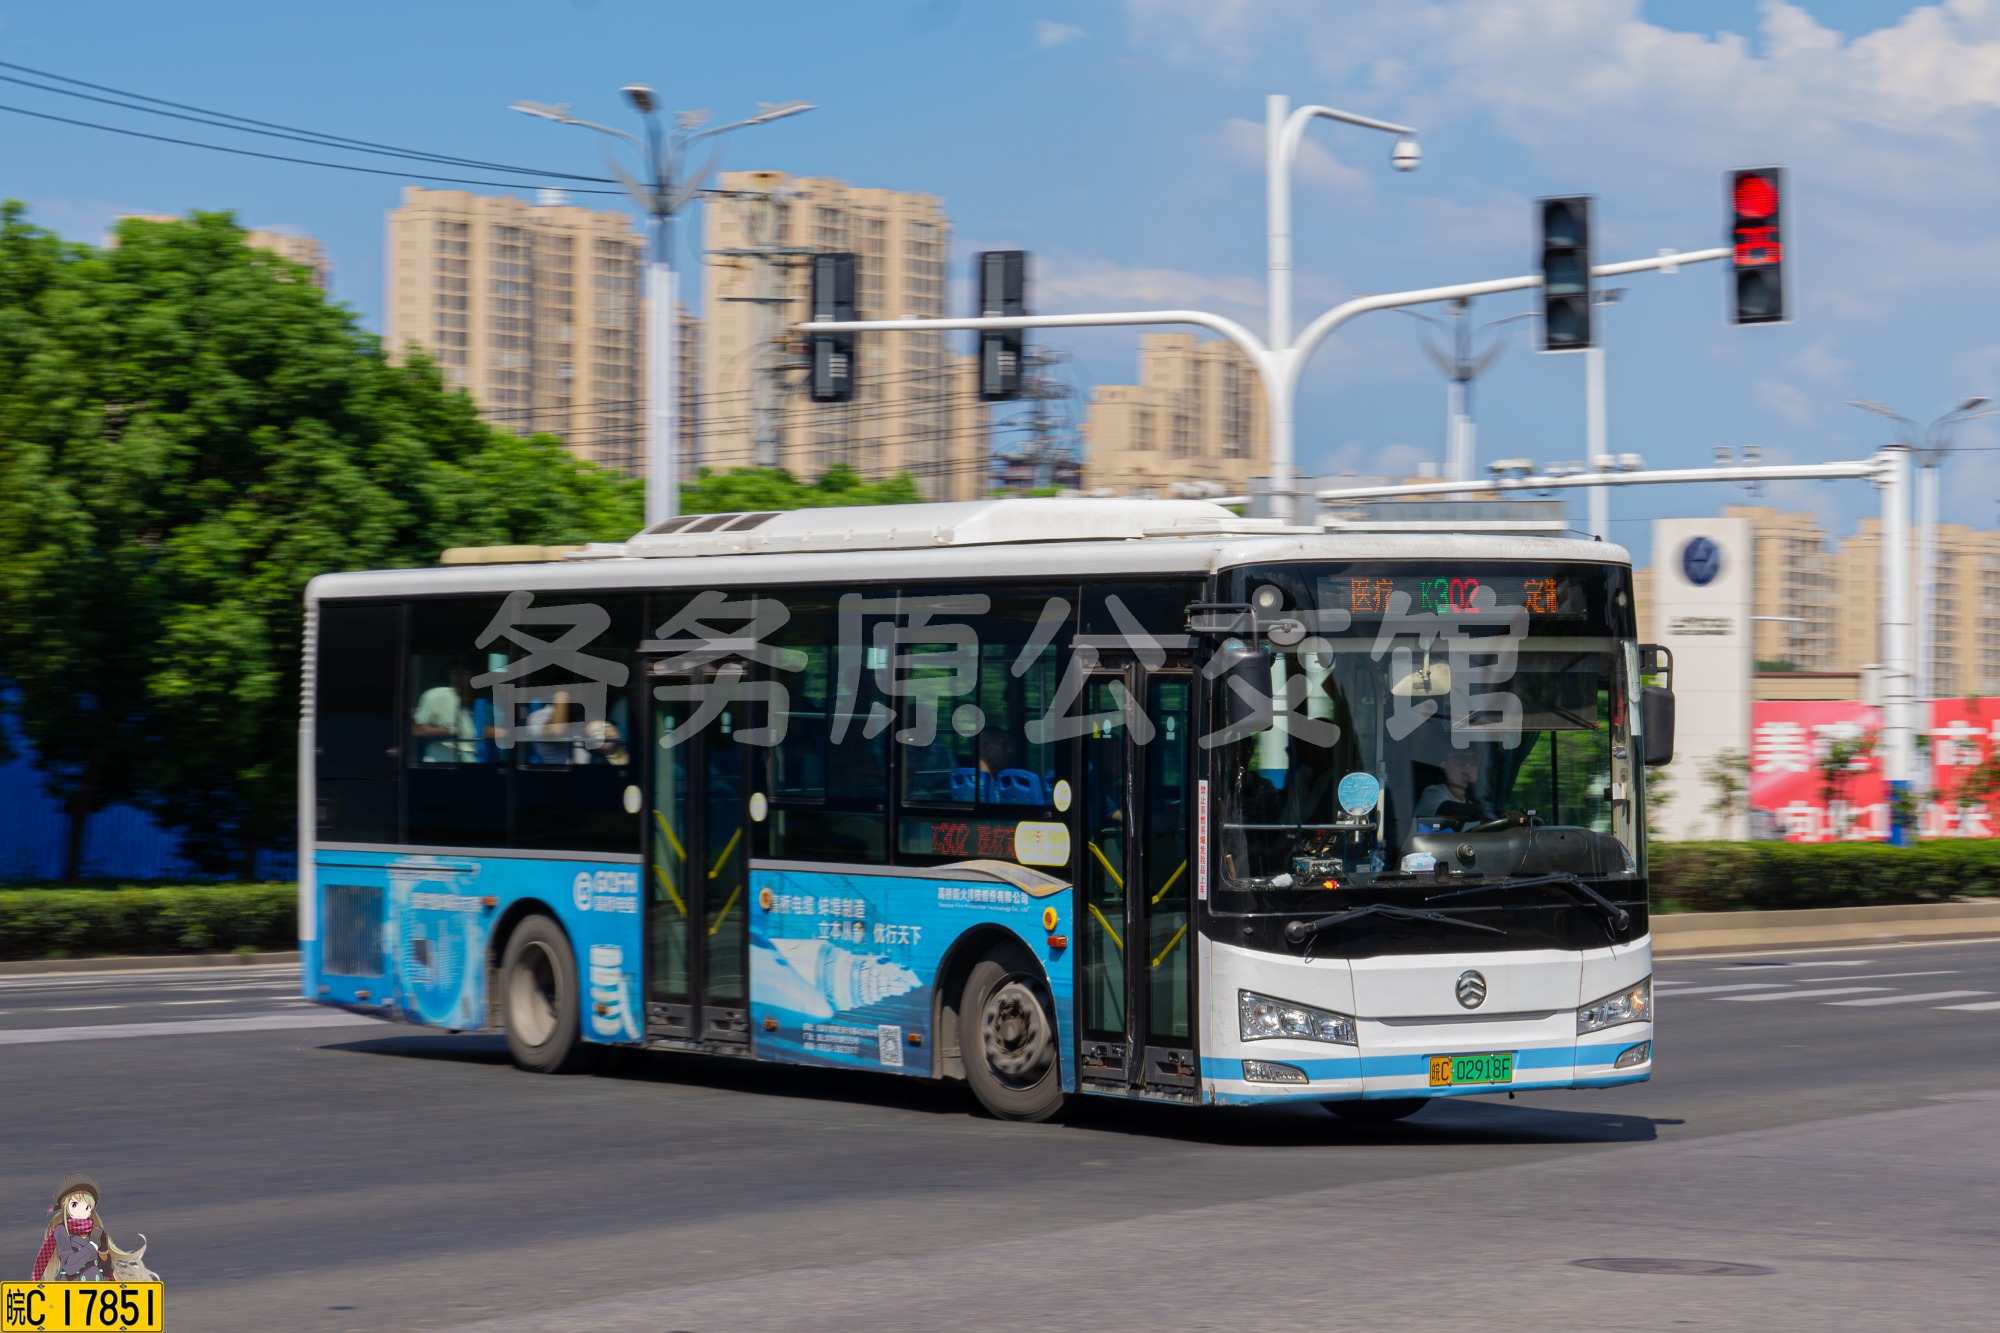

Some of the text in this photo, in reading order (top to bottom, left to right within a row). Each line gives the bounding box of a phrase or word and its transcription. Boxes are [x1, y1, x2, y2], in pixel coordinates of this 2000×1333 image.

[1350, 578, 1394, 614] 医疗
[1420, 577, 1481, 614] K302
[1456, 1057, 1511, 1080] 02918F
